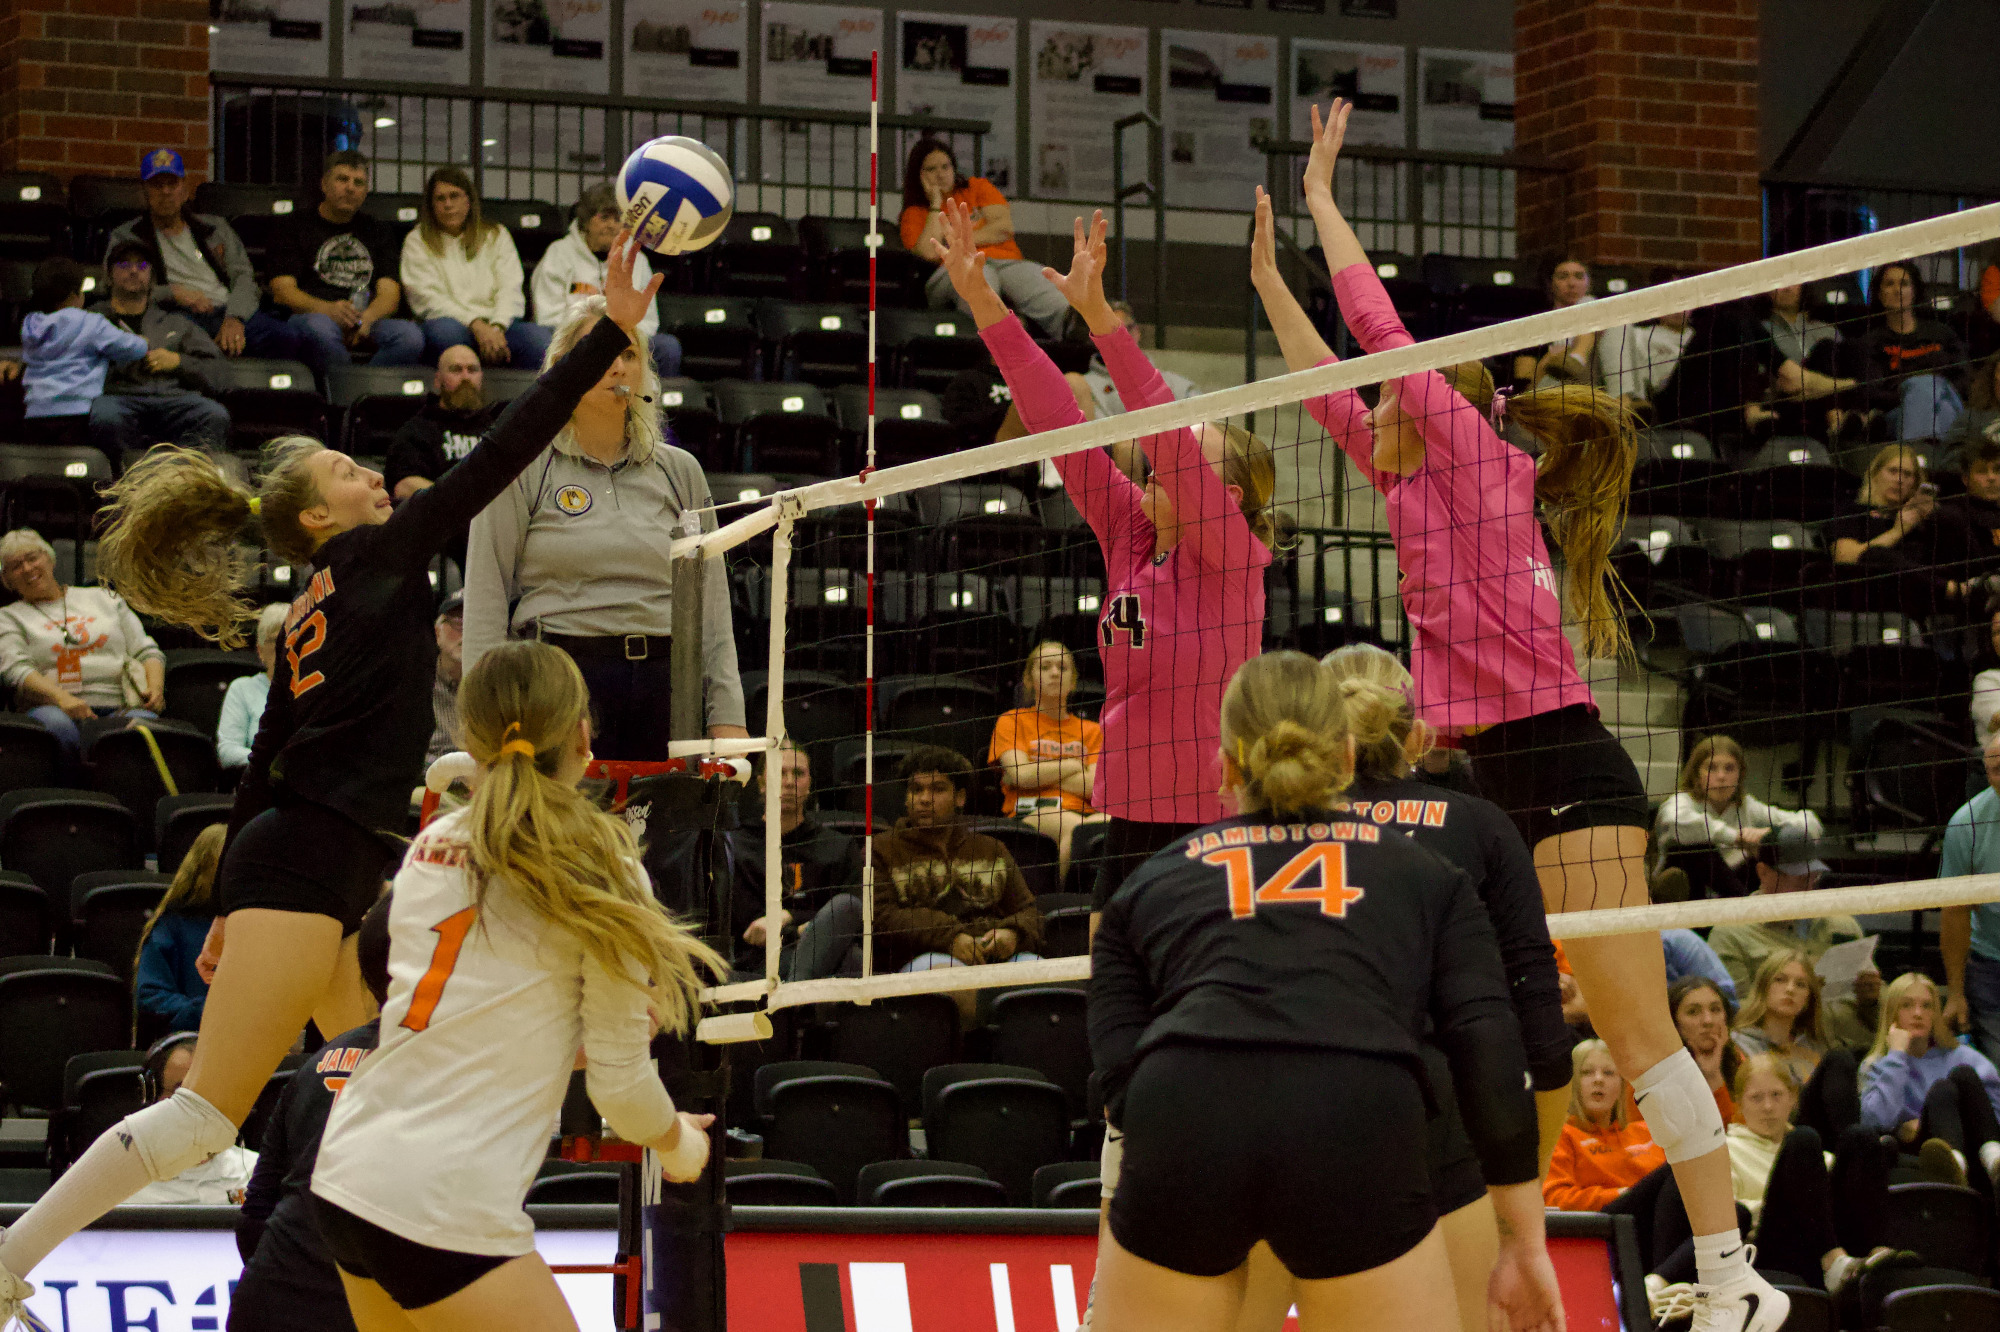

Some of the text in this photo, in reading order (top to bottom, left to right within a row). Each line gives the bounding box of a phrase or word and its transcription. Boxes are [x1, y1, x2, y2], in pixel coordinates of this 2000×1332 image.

[1101, 593, 1148, 649] 14
[1185, 821, 1380, 859] JAMESTOWN
[1201, 841, 1366, 920] 14
[398, 902, 478, 1034] 1
